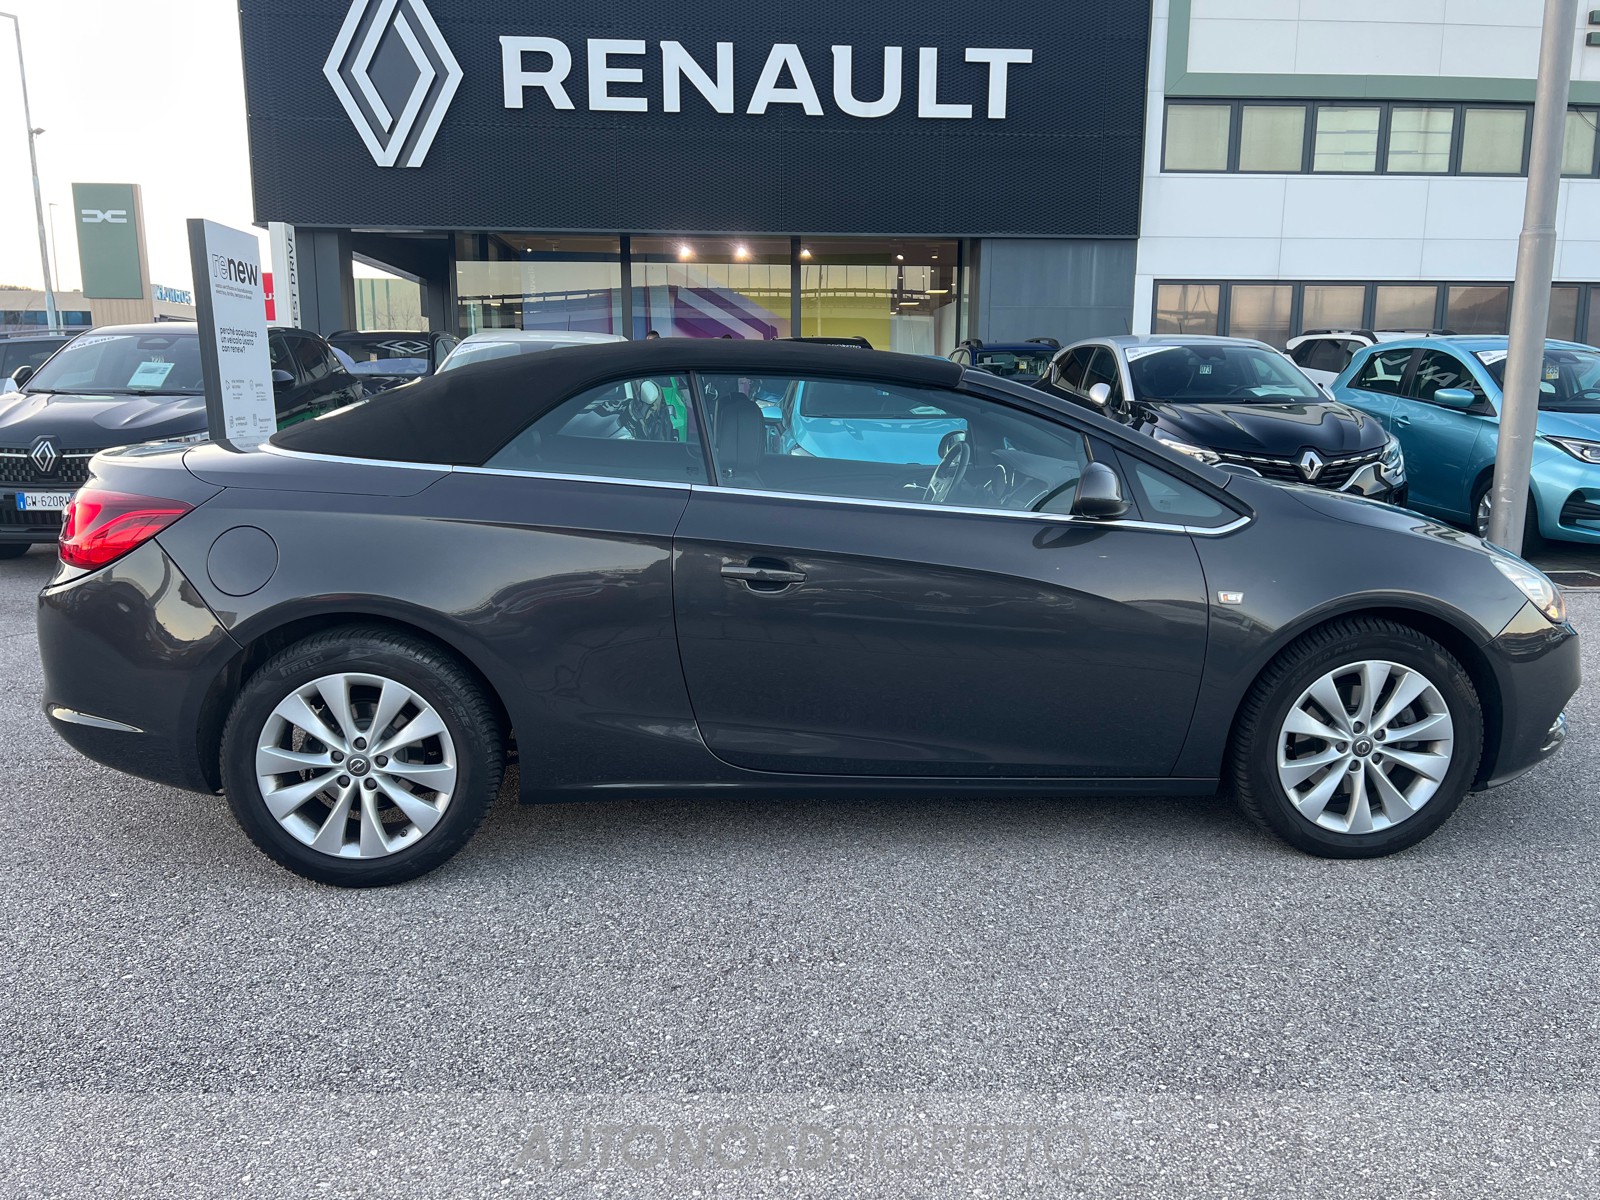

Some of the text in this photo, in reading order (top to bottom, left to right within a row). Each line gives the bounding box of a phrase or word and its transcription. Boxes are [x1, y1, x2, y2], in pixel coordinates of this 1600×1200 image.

[499, 36, 1033, 119] RENAULT
[212, 253, 258, 287] renew
[287, 231, 296, 285] DRIVE
[236, 328, 258, 338] acquistare
